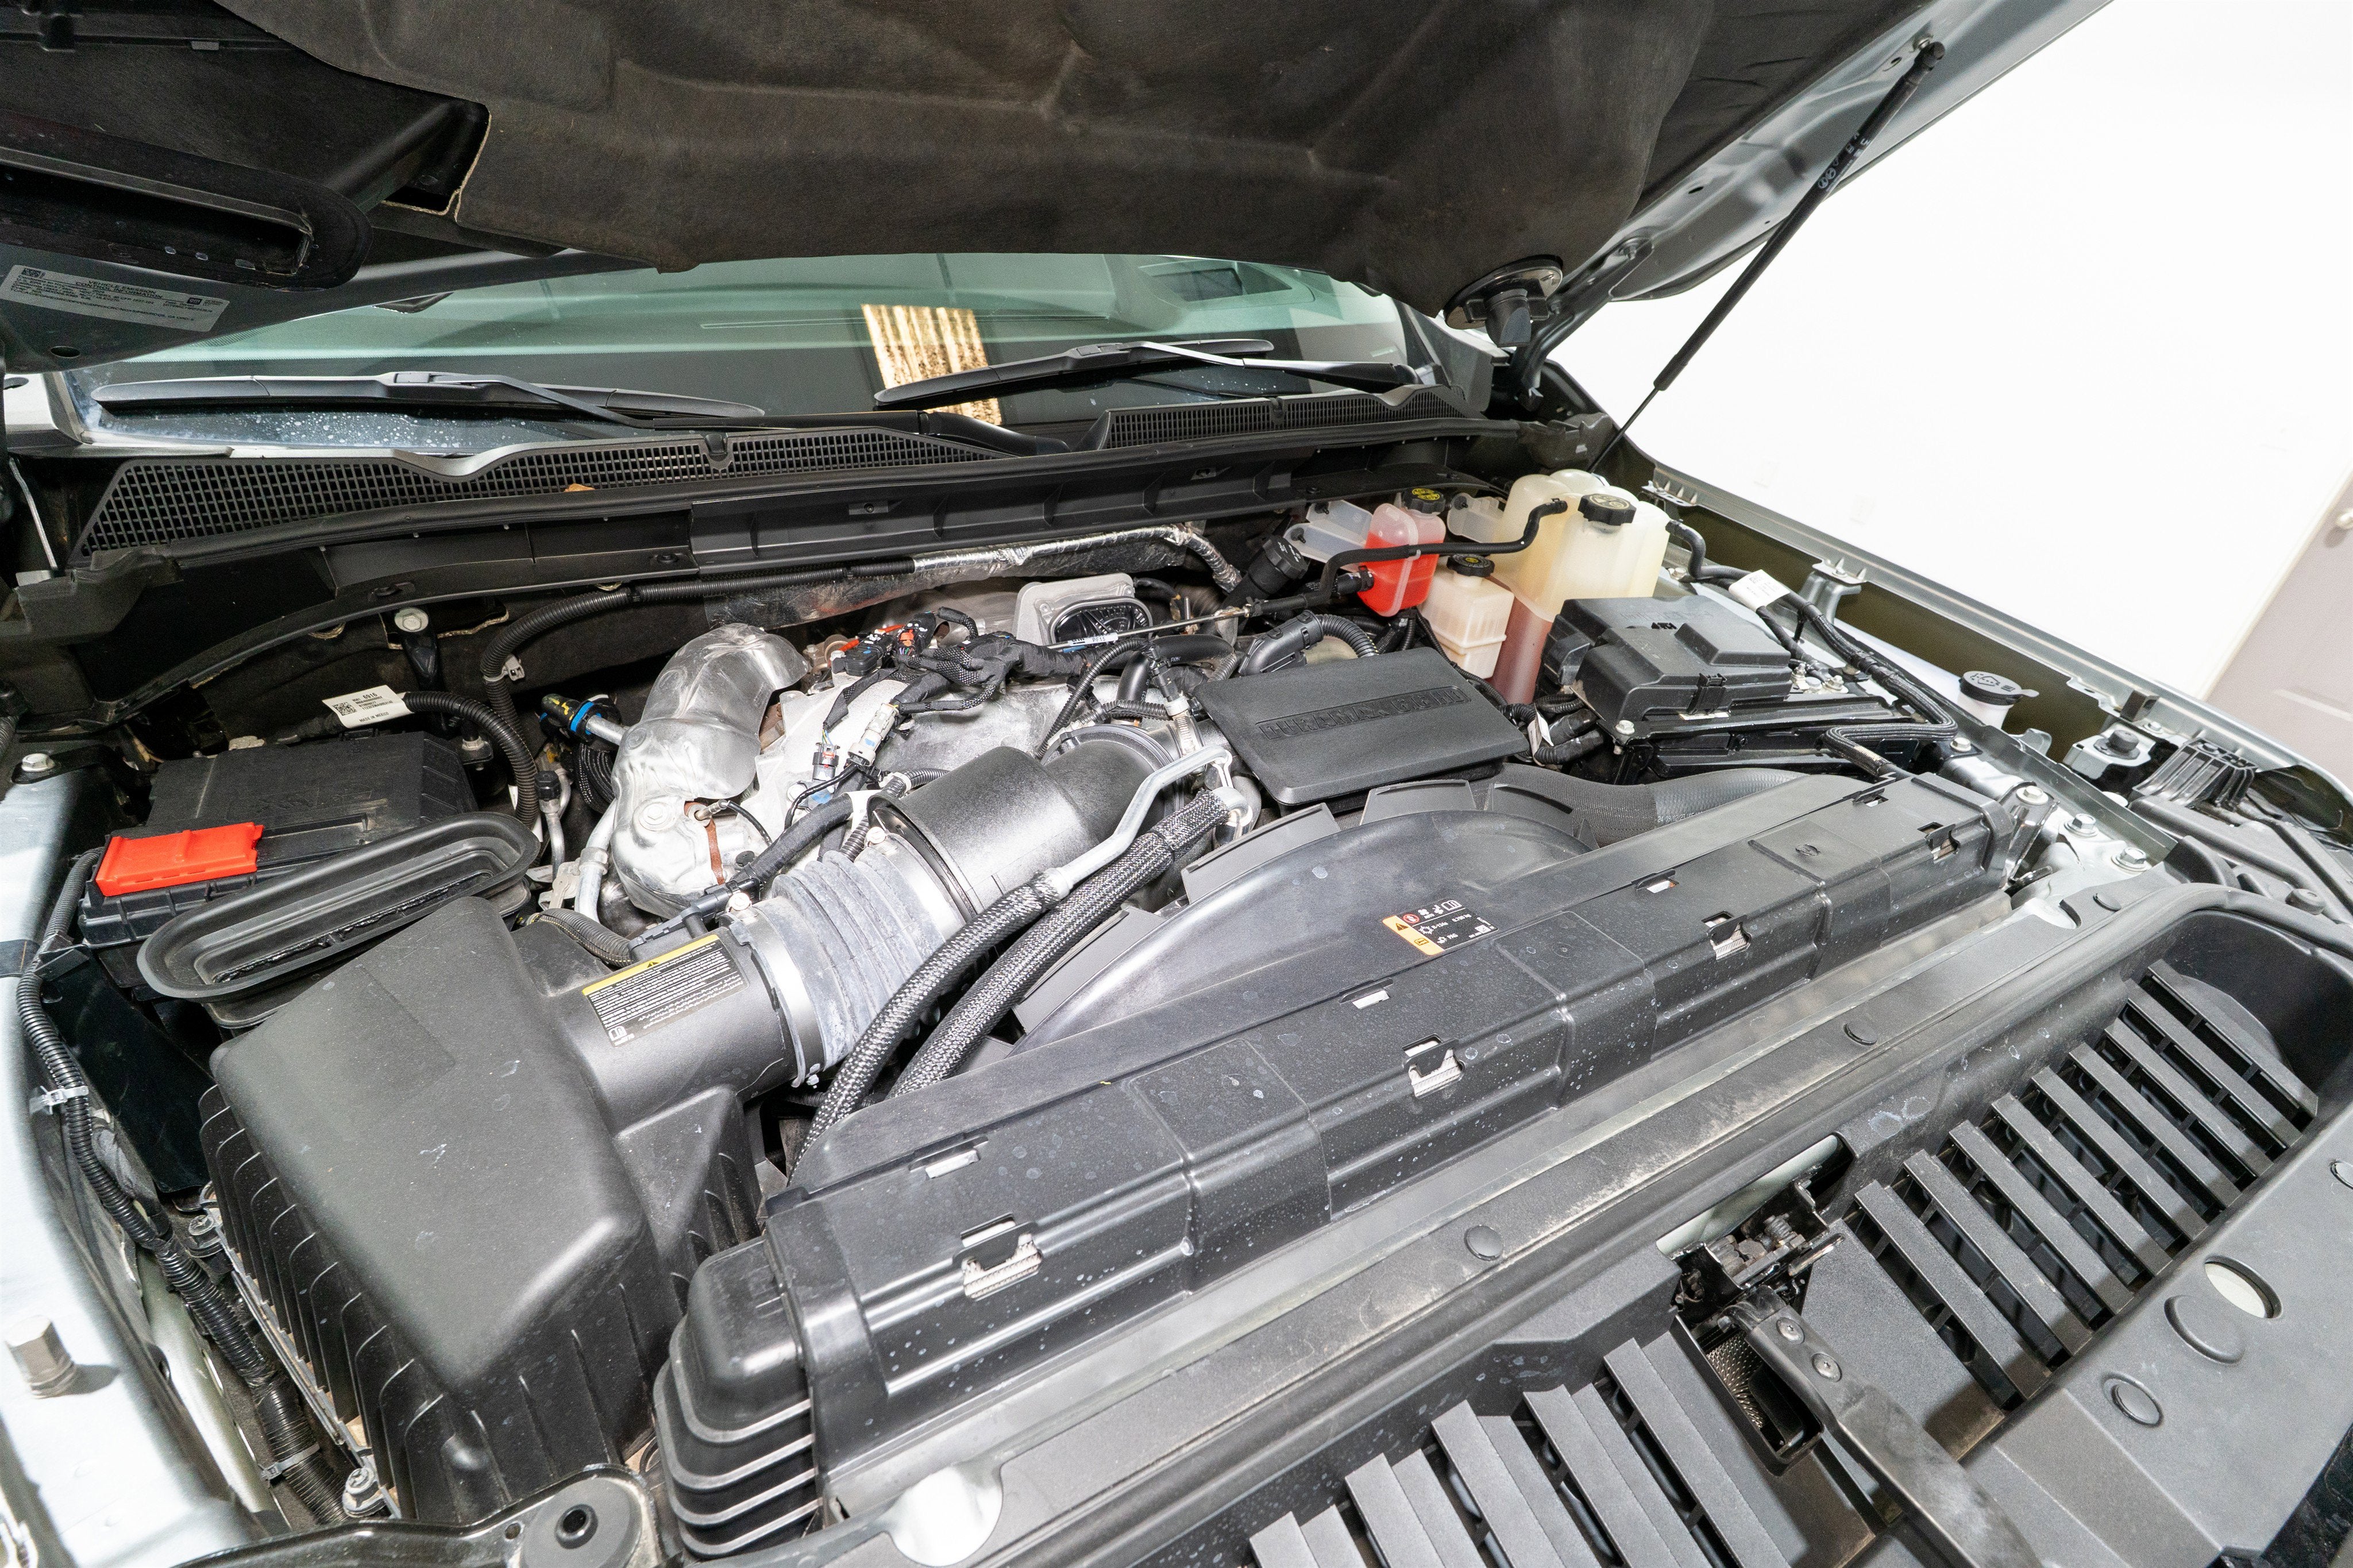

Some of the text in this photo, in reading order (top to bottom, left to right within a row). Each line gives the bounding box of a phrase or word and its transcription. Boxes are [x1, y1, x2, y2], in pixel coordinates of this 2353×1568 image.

[75, 282, 113, 291] CONTROL
[113, 288, 163, 298] INFORMATION
[88, 280, 119, 289] VEHICLE
[122, 286, 156, 294] EMISSION
[1258, 700, 1390, 740] DURAMAX
[1432, 689, 1468, 706] HD
